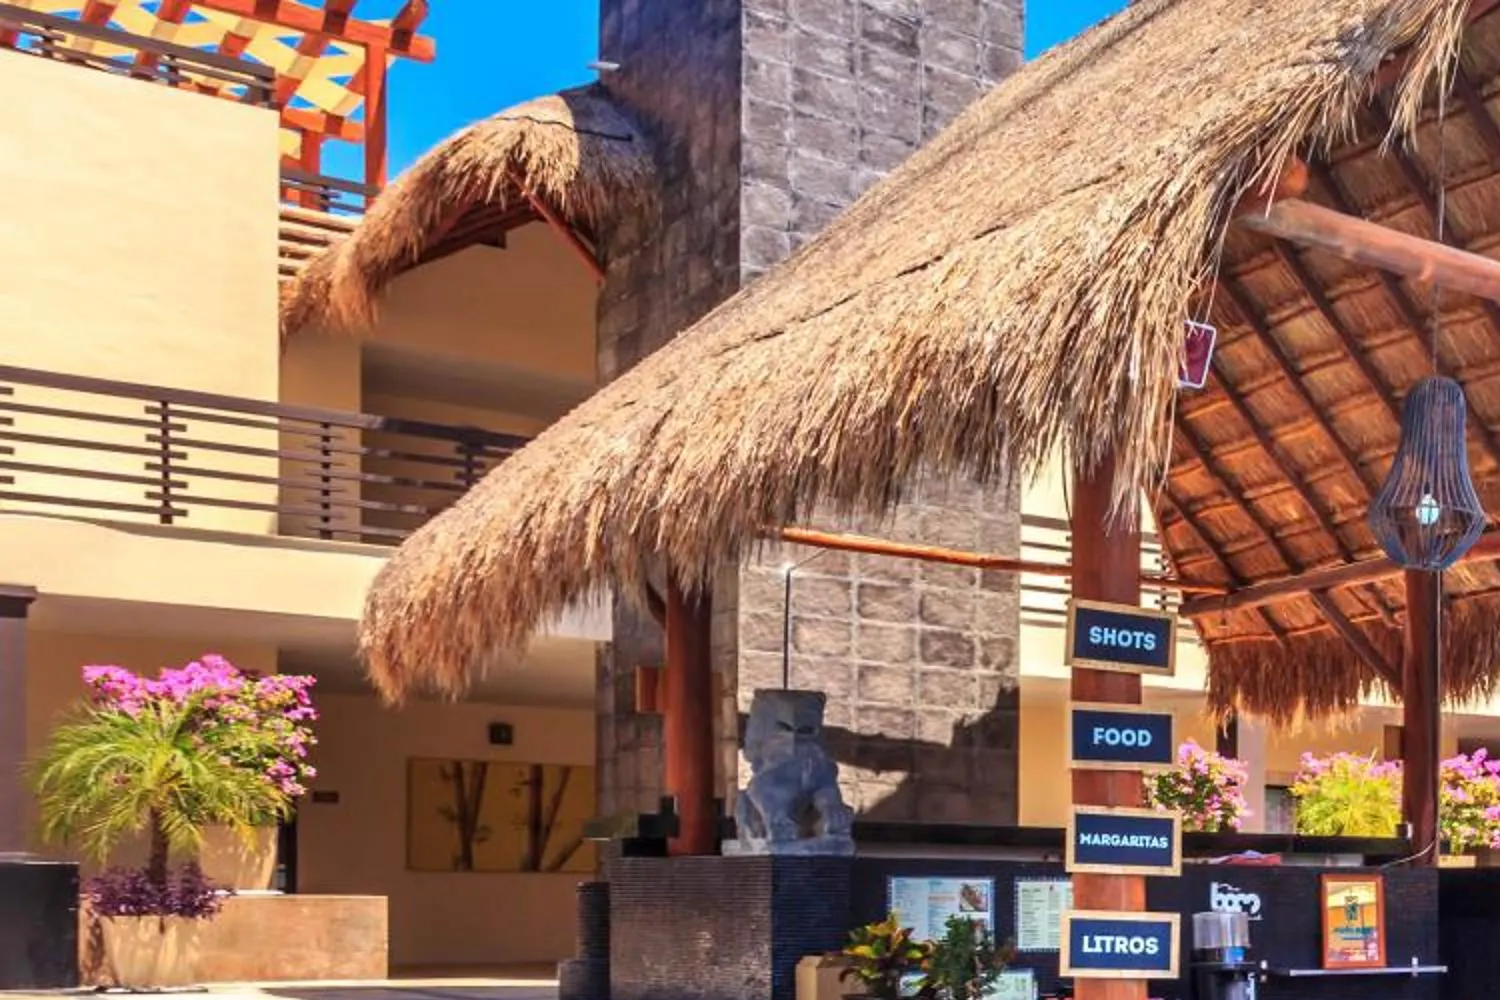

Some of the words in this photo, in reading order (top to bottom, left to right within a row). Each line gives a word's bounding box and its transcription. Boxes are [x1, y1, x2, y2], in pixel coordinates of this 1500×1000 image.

[1089, 625, 1156, 651] SHOTS
[1092, 727, 1153, 747] FOOD
[1079, 832, 1169, 849] MARGARITAS
[1082, 935, 1159, 955] LITROS
